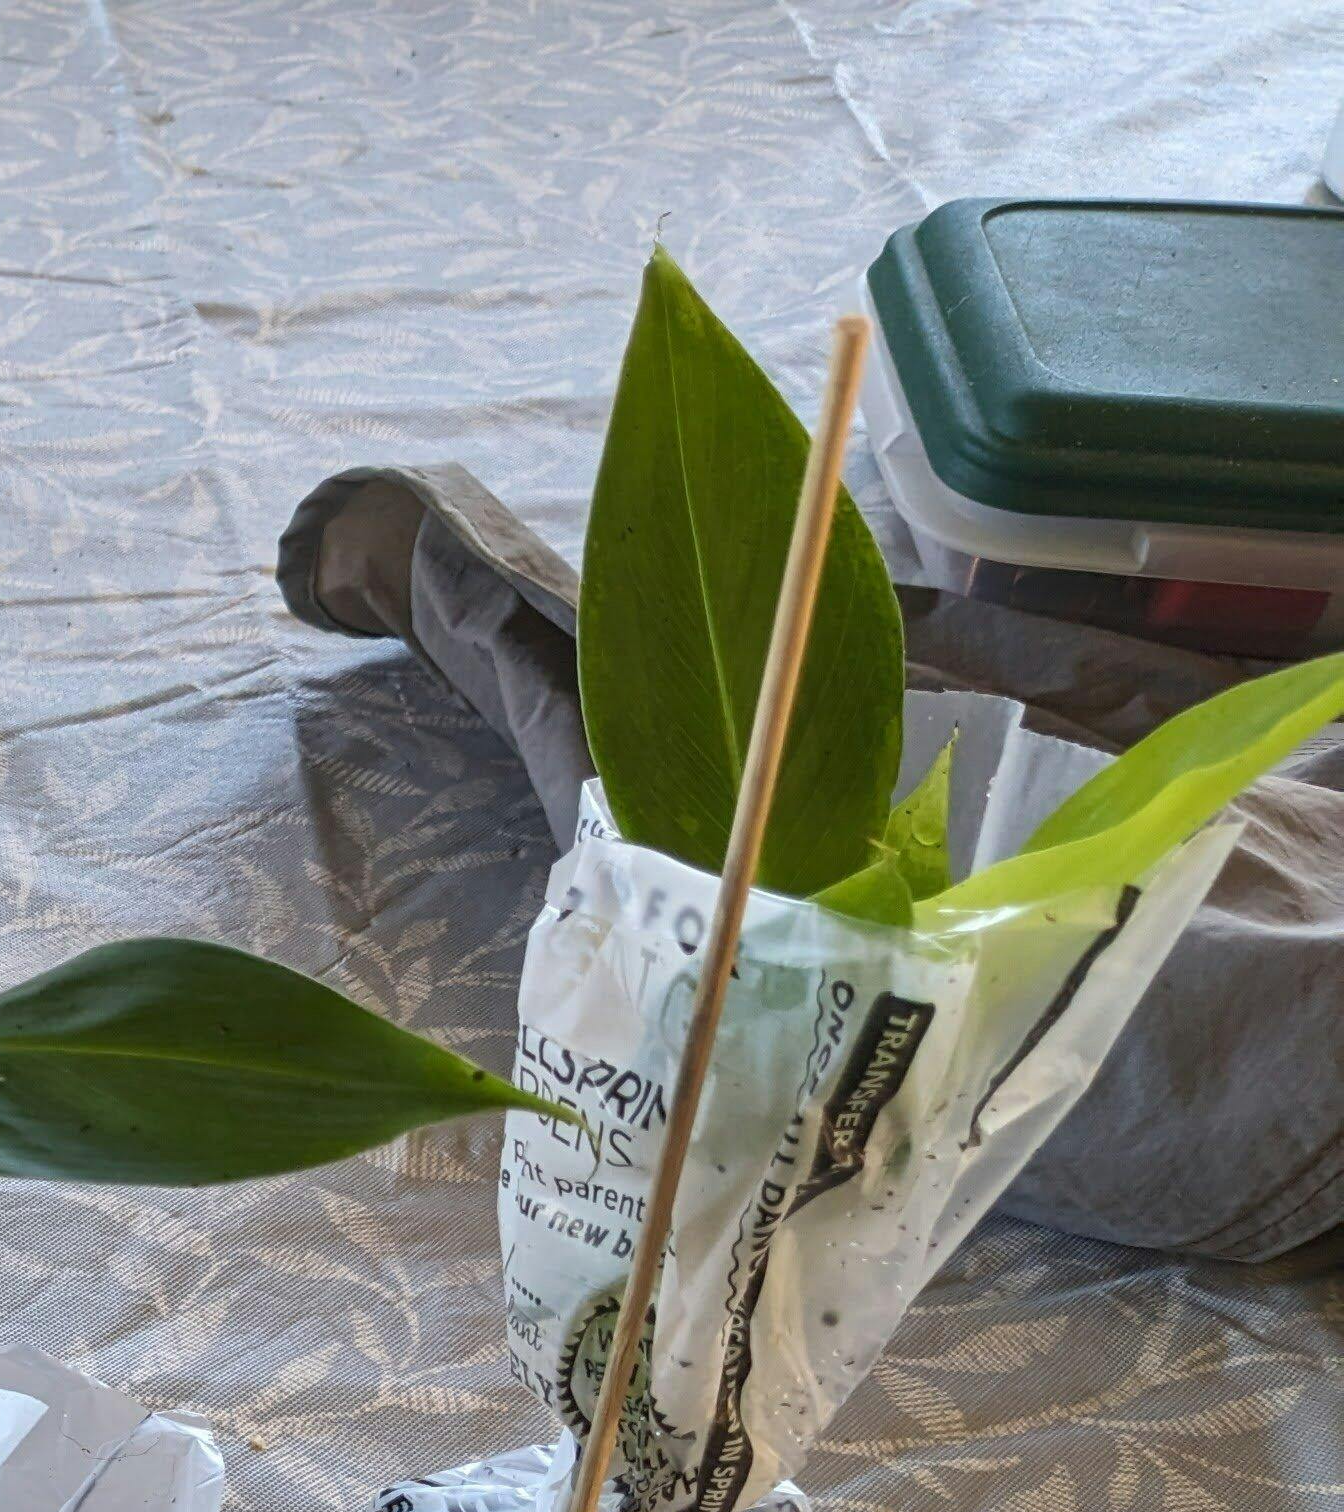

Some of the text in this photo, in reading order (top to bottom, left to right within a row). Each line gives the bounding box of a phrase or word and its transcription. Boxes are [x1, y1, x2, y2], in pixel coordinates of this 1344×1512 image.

[553, 1175, 646, 1223] parent
[547, 1209, 610, 1249] new
[721, 1438, 743, 1463] IN
